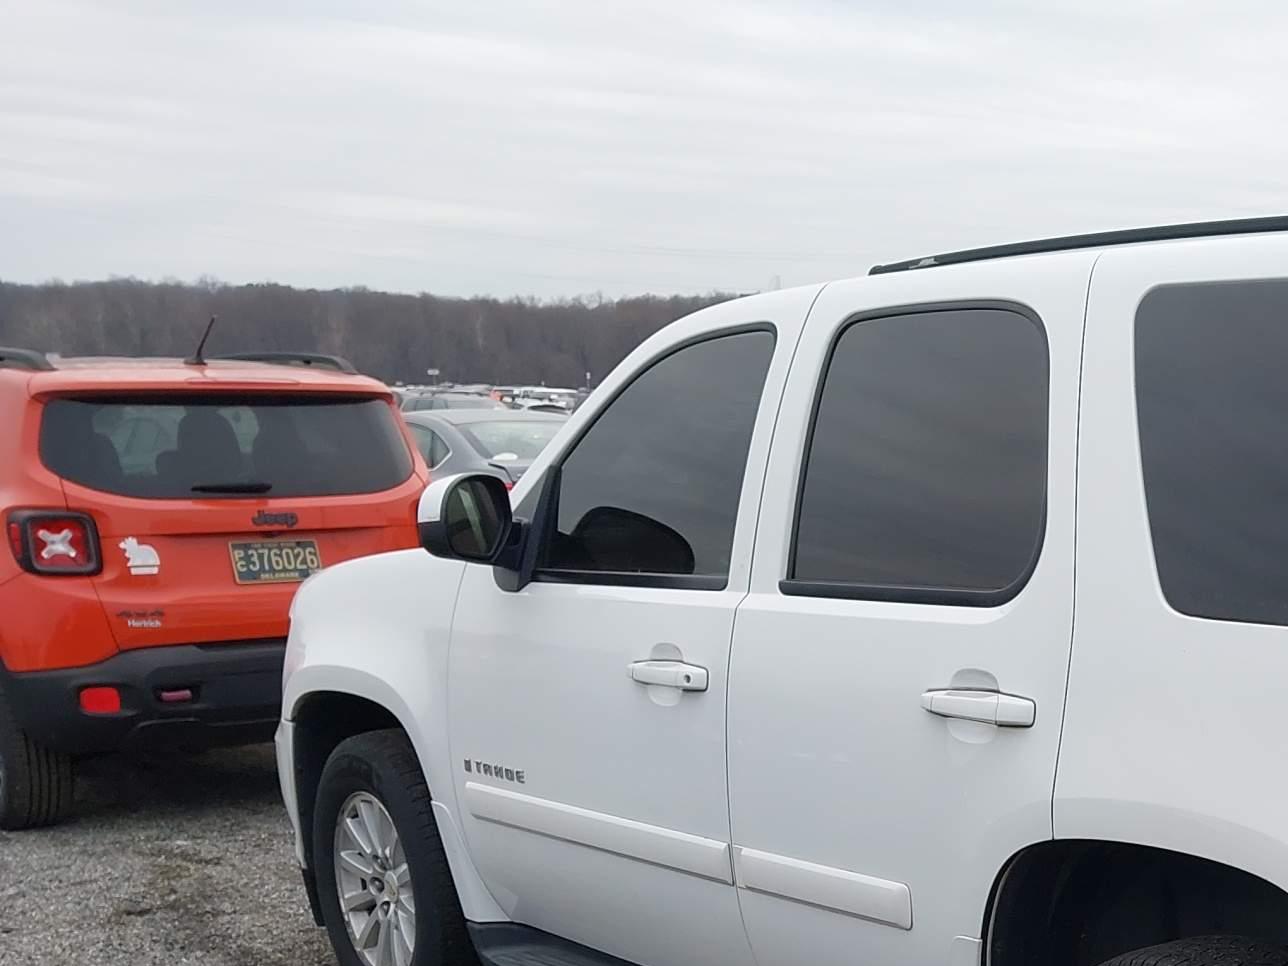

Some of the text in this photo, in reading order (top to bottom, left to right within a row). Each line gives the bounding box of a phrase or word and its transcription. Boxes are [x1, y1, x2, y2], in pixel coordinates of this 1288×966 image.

[251, 509, 298, 528] Jeep
[247, 547, 318, 571] 376026
[473, 760, 526, 785] TAHOE
